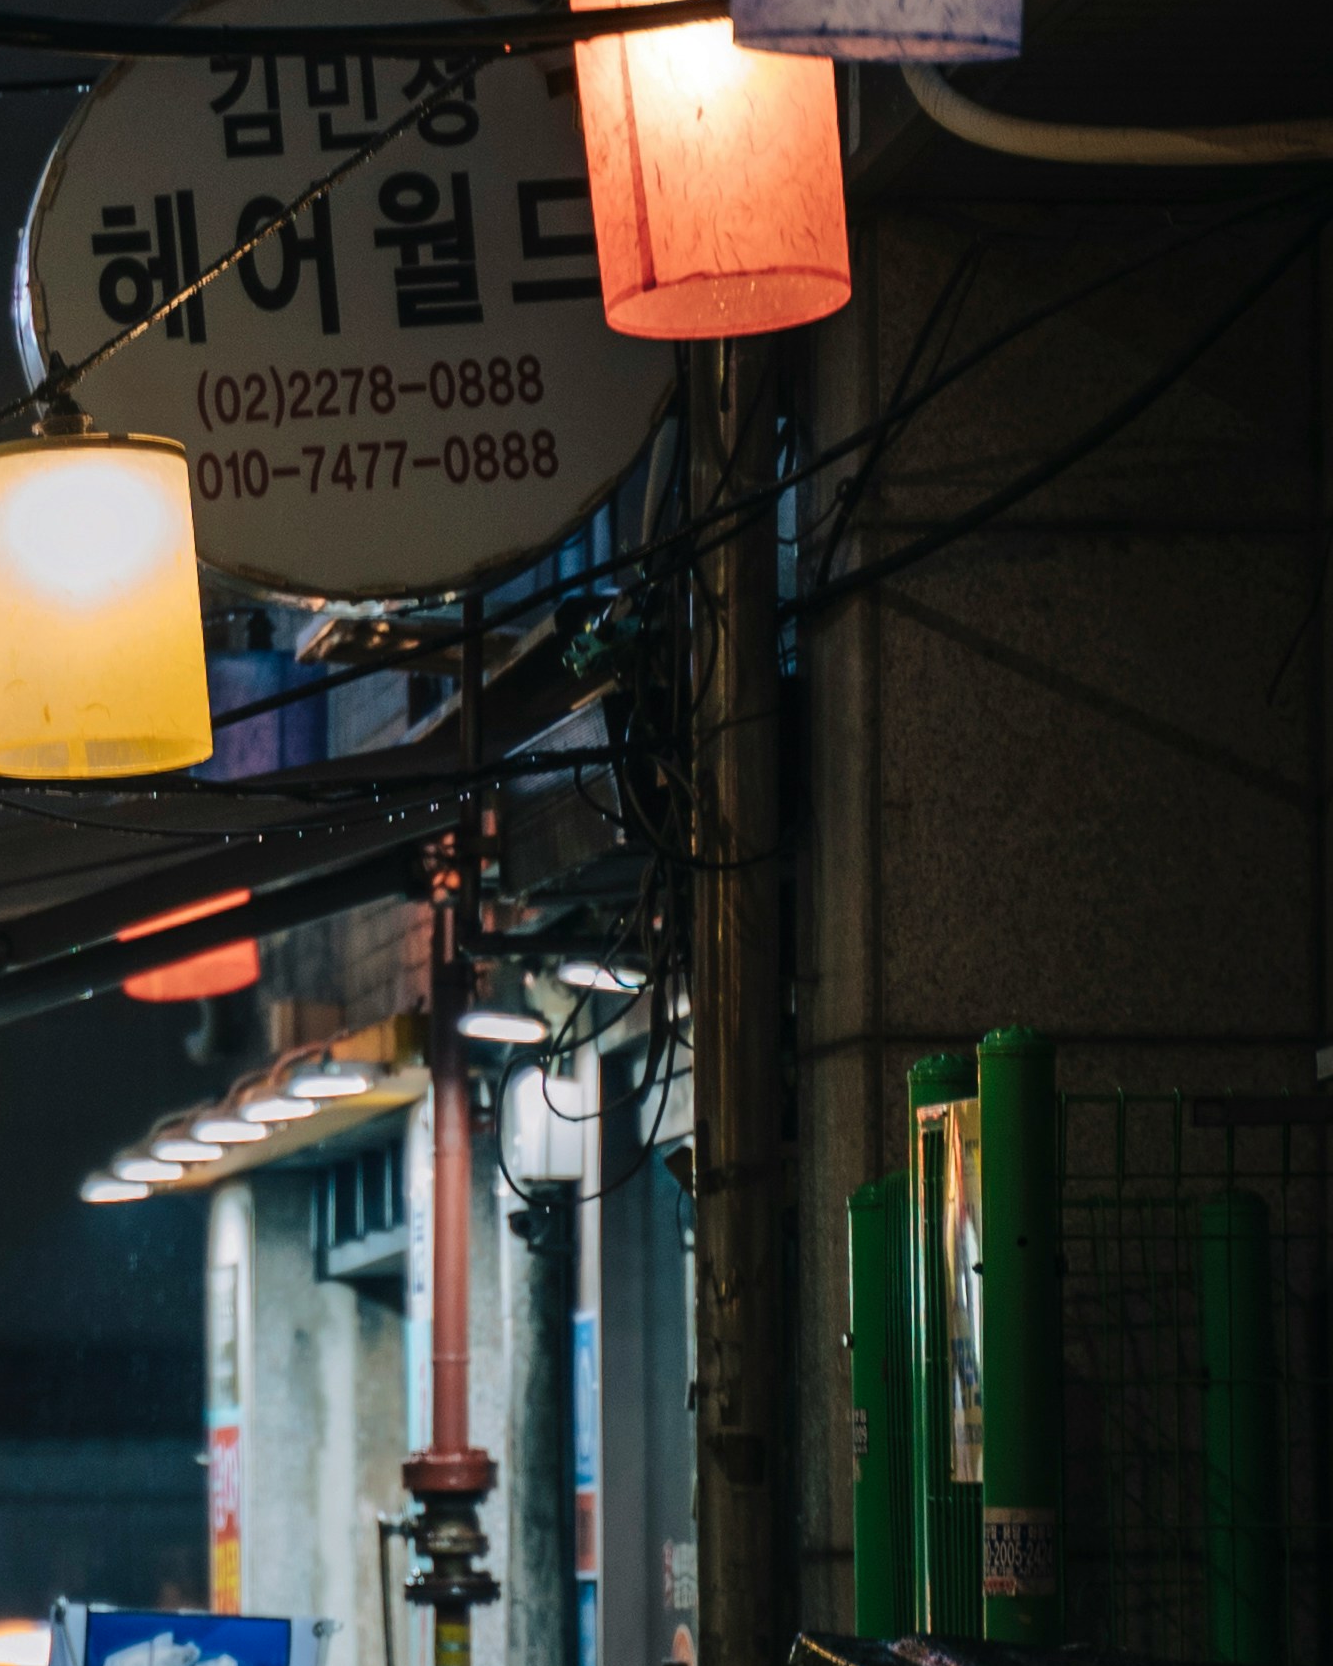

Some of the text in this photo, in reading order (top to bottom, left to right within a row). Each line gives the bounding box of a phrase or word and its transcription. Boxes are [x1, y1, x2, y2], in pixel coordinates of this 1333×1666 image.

[91, 170, 599, 345] 헤어월드
[196, 355, 546, 433] (02)2278-0888
[196, 431, 561, 503] 010-7477-0888
